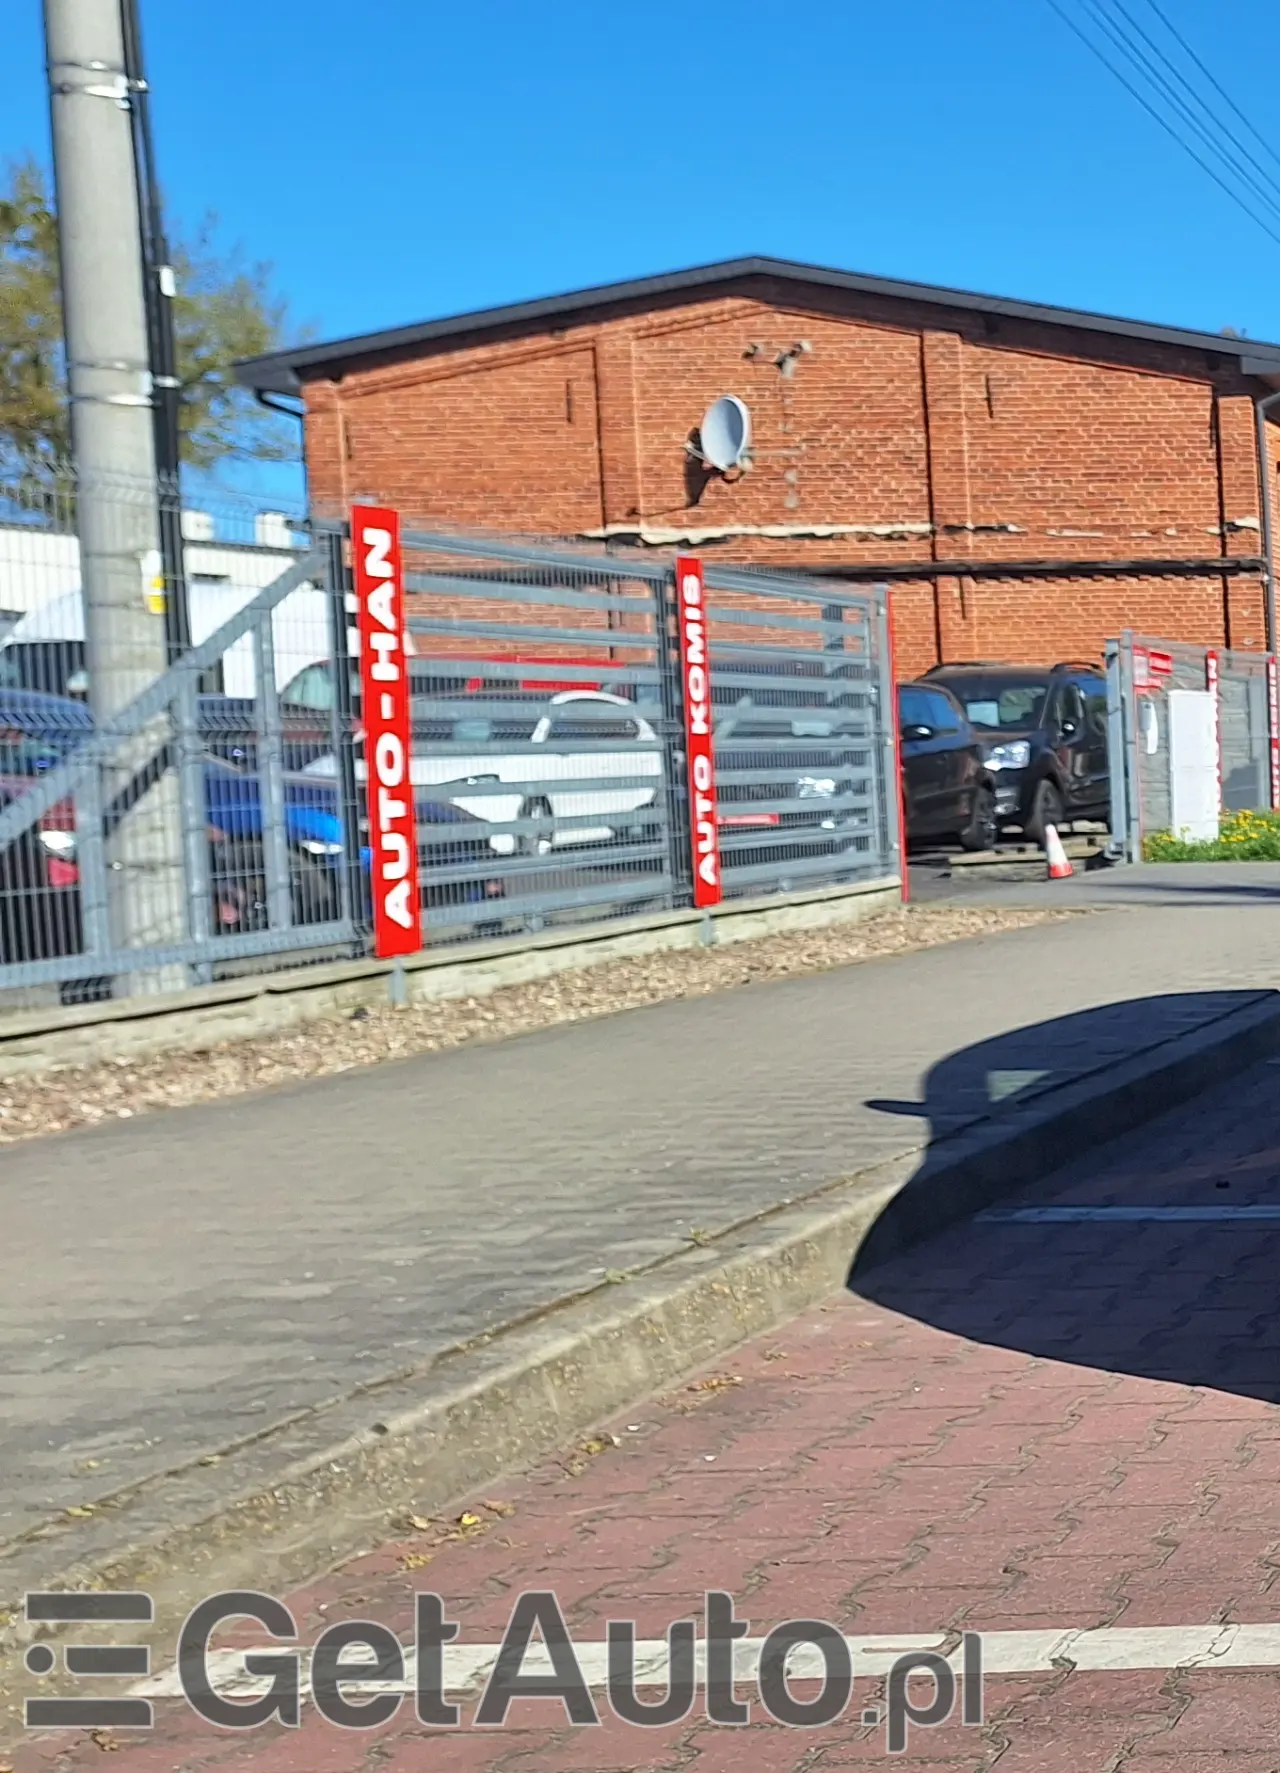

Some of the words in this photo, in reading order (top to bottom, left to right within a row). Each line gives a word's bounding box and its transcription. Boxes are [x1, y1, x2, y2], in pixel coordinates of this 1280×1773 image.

[682, 576, 709, 735] KOMIS
[376, 733, 412, 929] AUTO
[693, 754, 717, 885] AUTO
